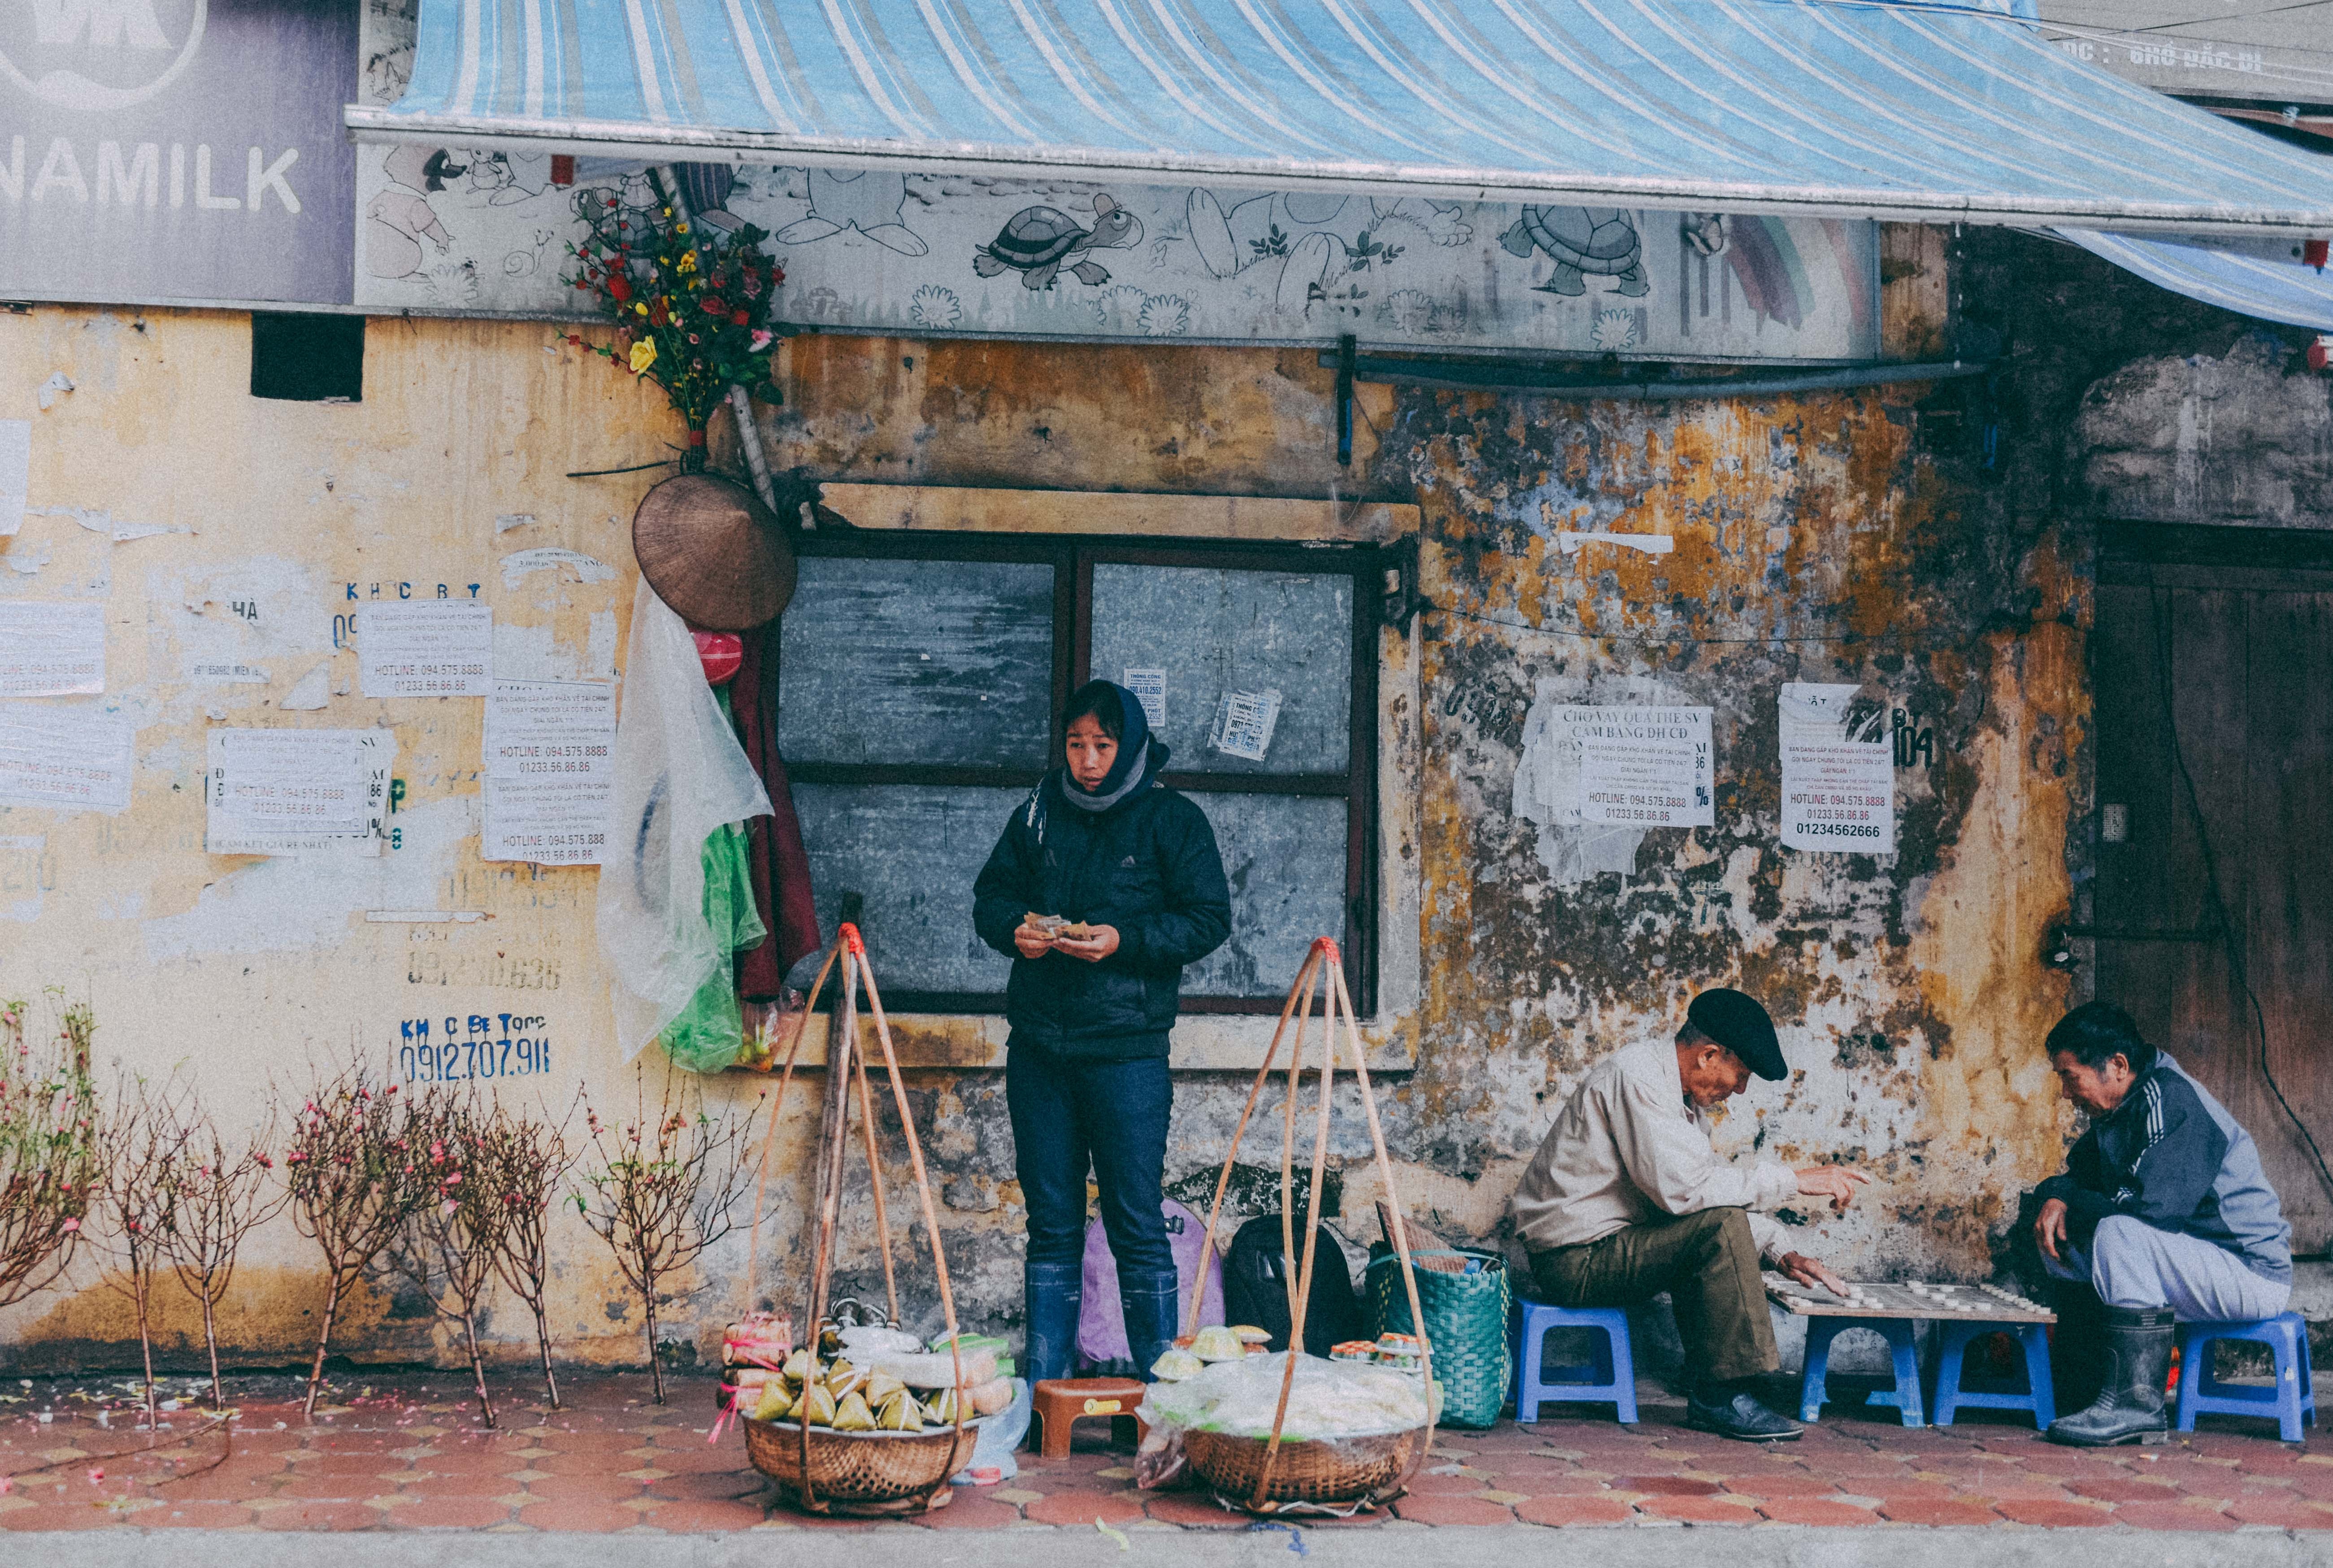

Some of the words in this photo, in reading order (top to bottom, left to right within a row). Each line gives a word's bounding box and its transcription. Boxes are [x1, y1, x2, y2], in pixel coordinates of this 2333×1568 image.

[545, 746, 608, 757] 094.575.8888
[519, 761, 590, 773] 01233.56.86.86
[1589, 791, 1628, 804] HOTLINE:
[1629, 795, 1686, 808] 094.575.8888
[1790, 793, 1828, 804] HOTLINE:
[1830, 795, 1886, 807] 094.575.8888
[1606, 808, 1670, 821] 01233.56.86.86
[1807, 809, 1869, 820] 01233.56.86.86
[1797, 823, 1880, 837] 01234562666
[503, 835, 546, 847] HOTLINE:
[523, 849, 593, 861] 01233.56.86.86
